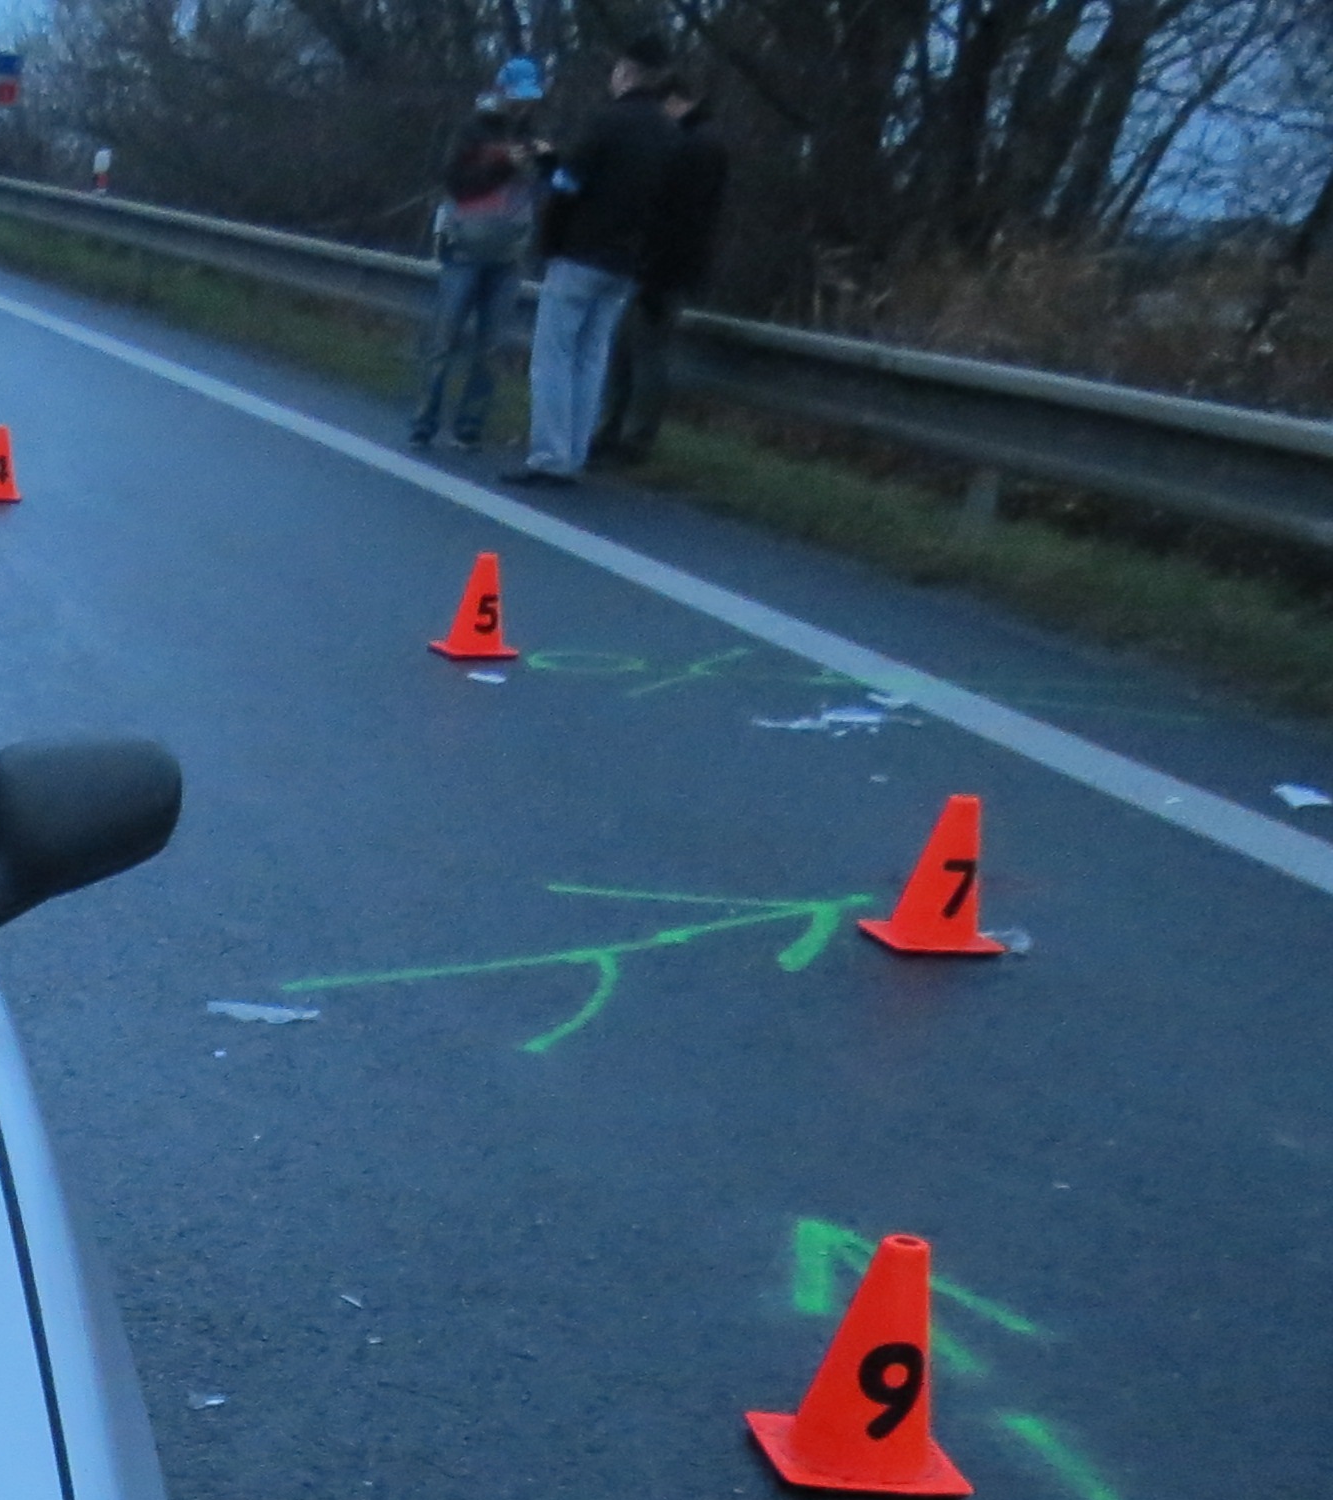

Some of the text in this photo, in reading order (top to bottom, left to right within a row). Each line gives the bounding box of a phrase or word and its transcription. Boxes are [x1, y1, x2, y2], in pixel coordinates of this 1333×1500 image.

[474, 594, 499, 634] 5
[942, 858, 978, 919] 7
[858, 1342, 924, 1440] 9
